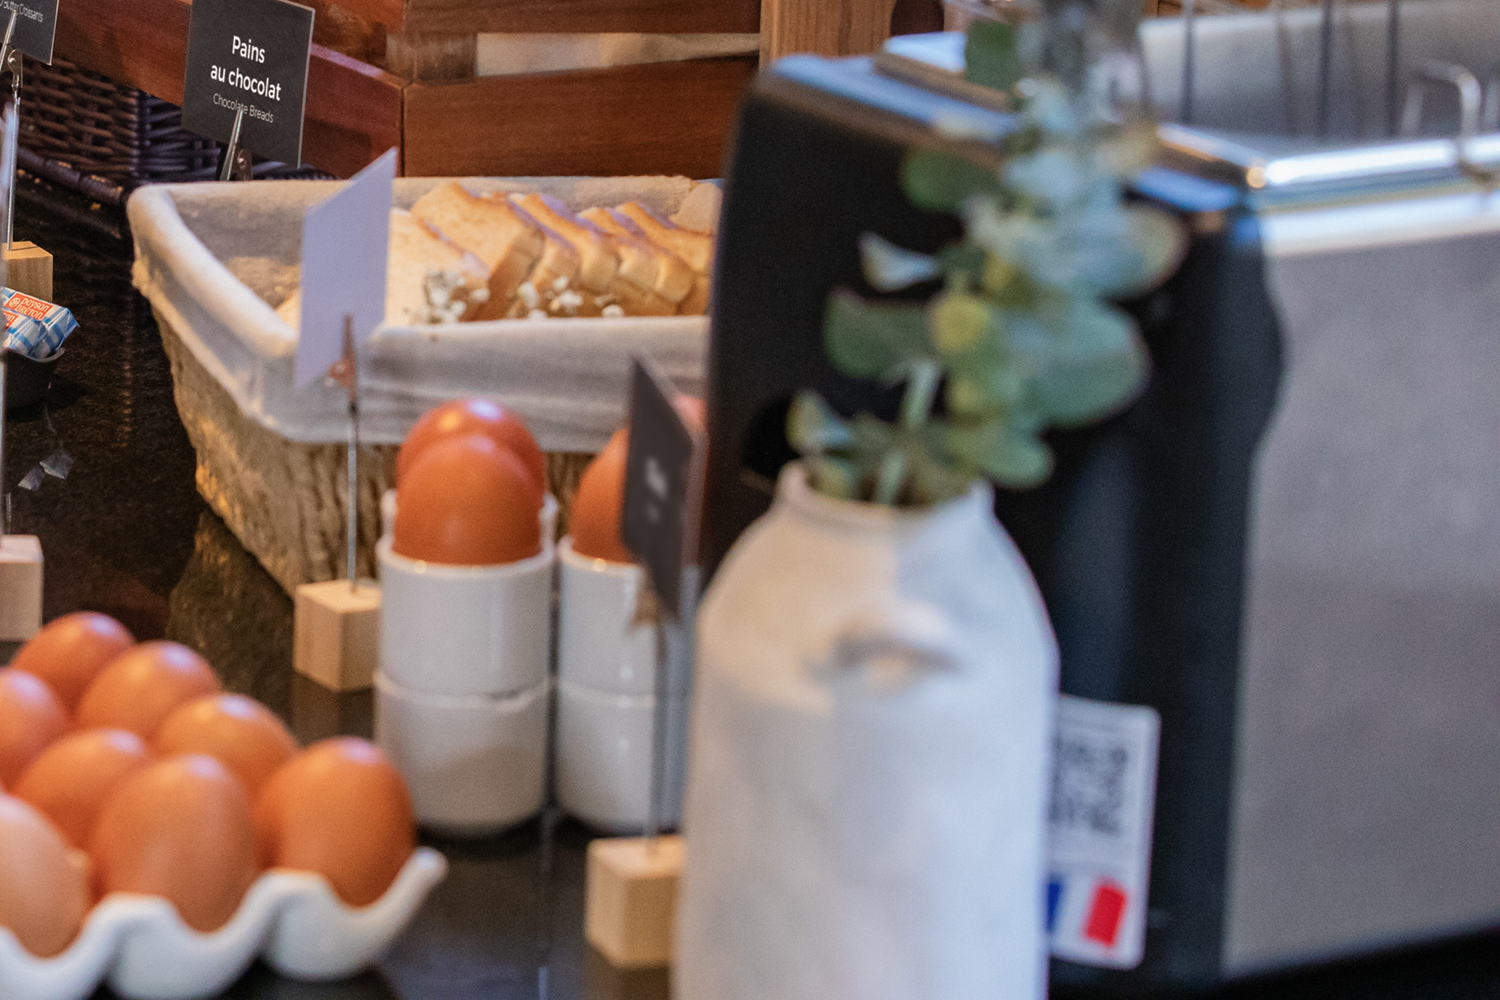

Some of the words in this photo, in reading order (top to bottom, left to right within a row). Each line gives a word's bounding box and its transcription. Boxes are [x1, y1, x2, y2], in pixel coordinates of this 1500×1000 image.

[19, 3, 44, 23] Croissants
[231, 35, 265, 64] Pains
[210, 64, 226, 83] au
[228, 68, 282, 101] chocolat
[213, 92, 249, 115] Chocolate
[249, 104, 274, 123] Breads
